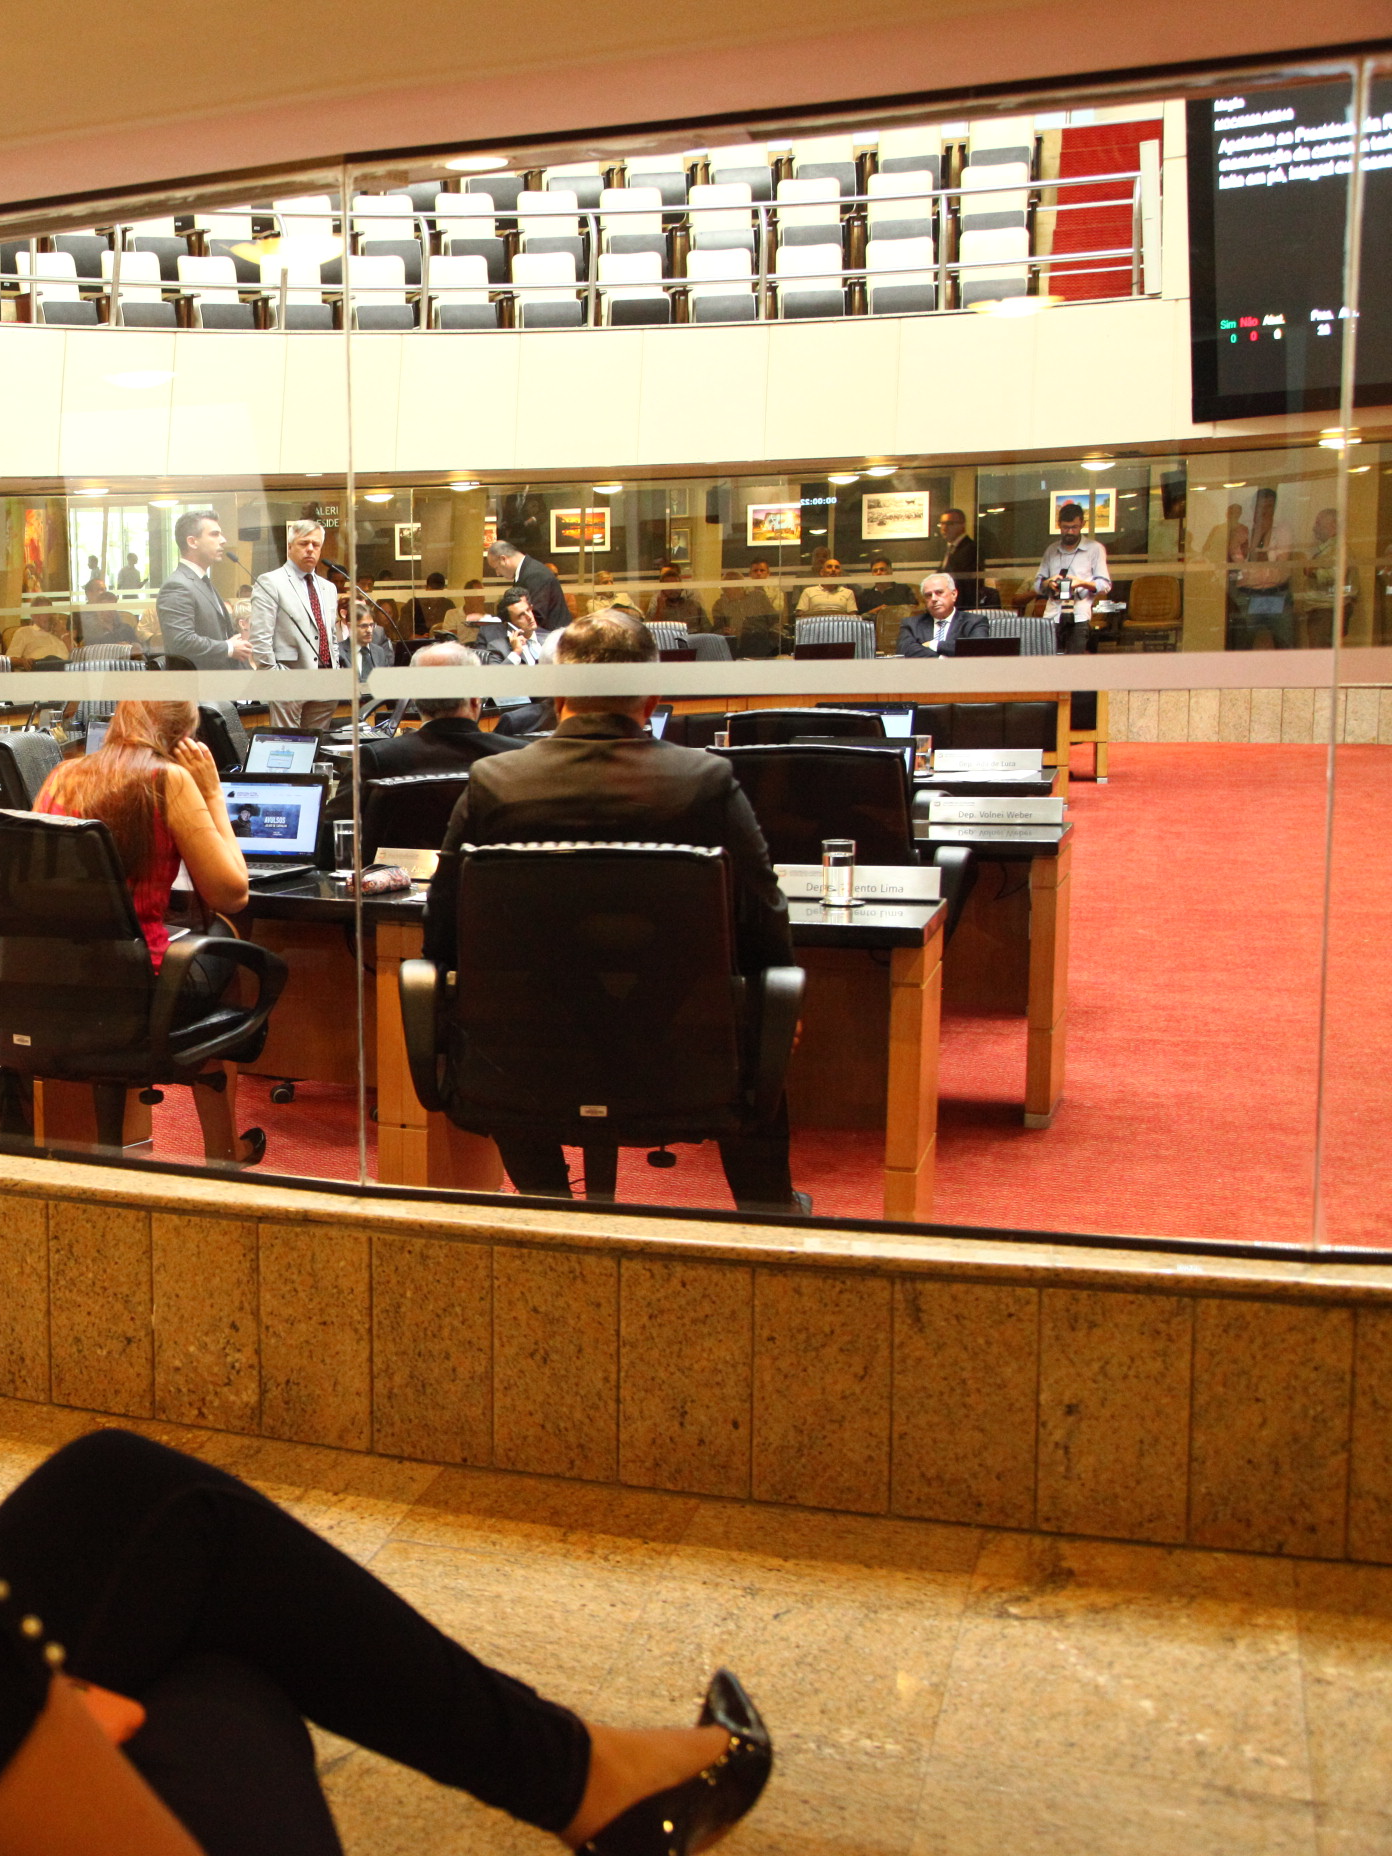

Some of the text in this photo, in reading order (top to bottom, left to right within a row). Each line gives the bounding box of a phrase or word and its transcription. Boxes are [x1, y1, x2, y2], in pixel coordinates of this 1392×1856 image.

[1220, 319, 1237, 330] Sim
[1239, 316, 1259, 328] Não
[1230, 333, 1238, 344] 0
[1249, 330, 1258, 341] 0
[958, 810, 1033, 820] Dep. Volnei Weber
[806, 882, 825, 894] Dep
[880, 883, 904, 893] Lima
